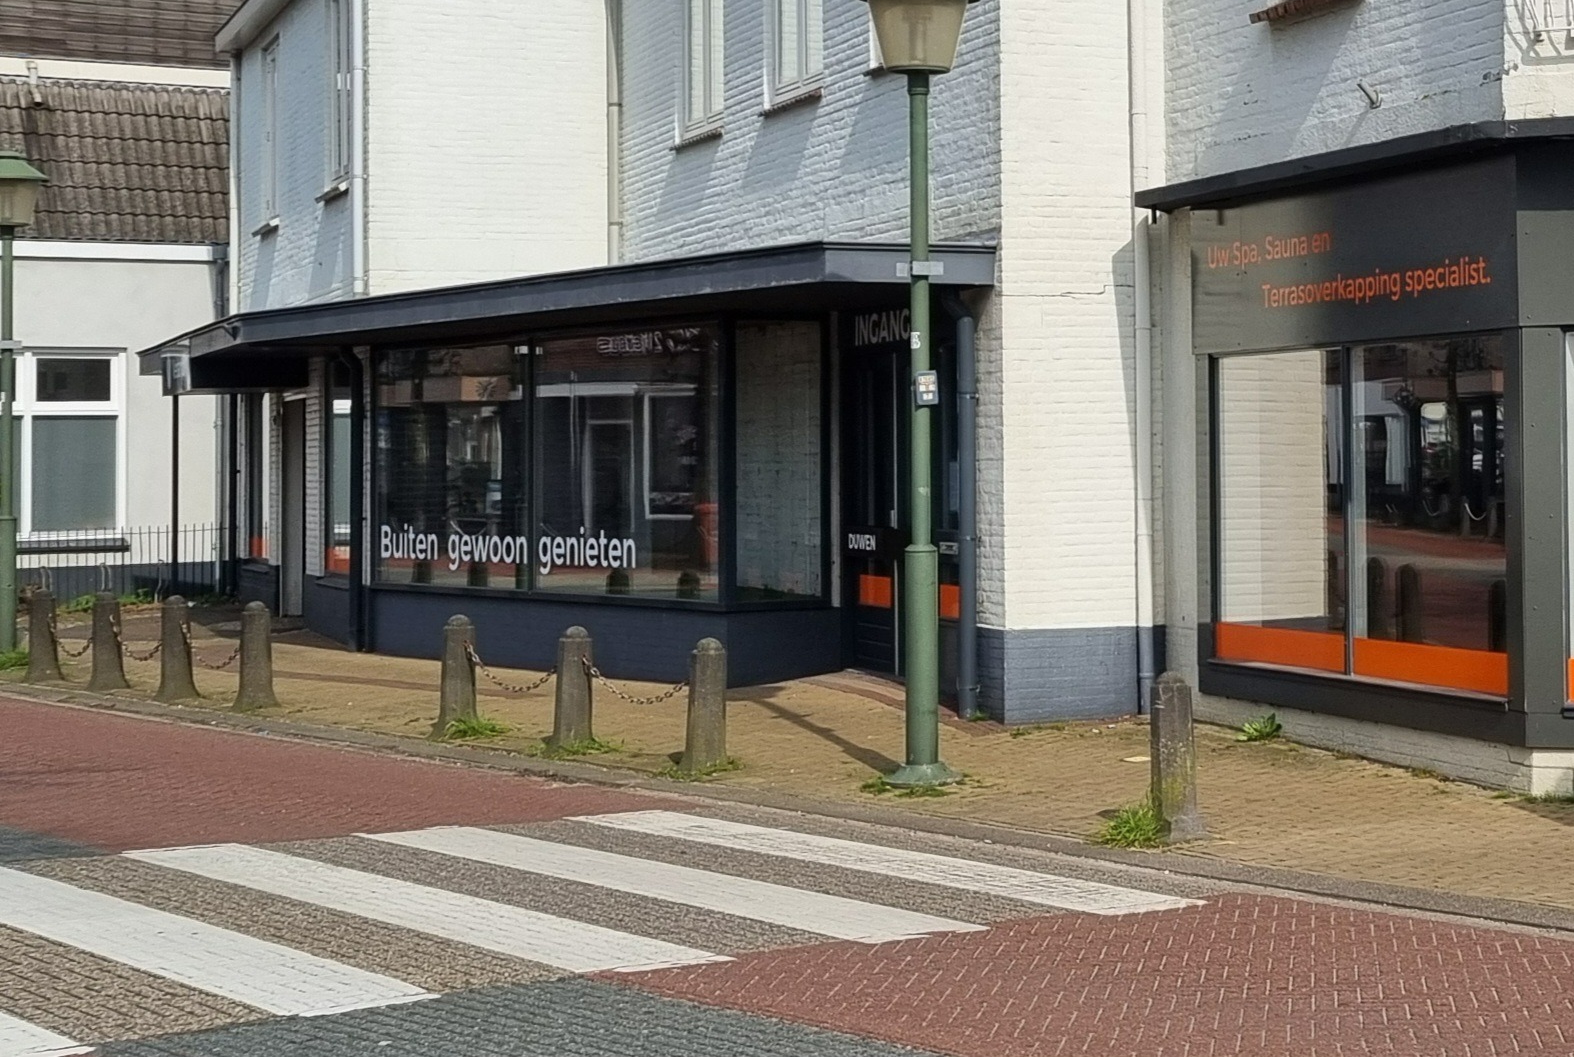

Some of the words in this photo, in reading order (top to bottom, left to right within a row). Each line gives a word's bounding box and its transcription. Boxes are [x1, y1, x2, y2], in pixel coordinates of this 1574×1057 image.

[1207, 246, 1229, 268] Uw
[1233, 241, 1262, 269] Spa,
[1265, 235, 1308, 261] Sauna
[1311, 232, 1331, 254] en
[1262, 268, 1401, 309] Terrasoverkapping
[1405, 256, 1491, 297] specialist.
[855, 308, 911, 347] INGANG
[380, 524, 438, 560] Buiten
[448, 534, 528, 571] gewoon
[538, 526, 636, 575] genieten
[848, 533, 876, 551] DUWEN
